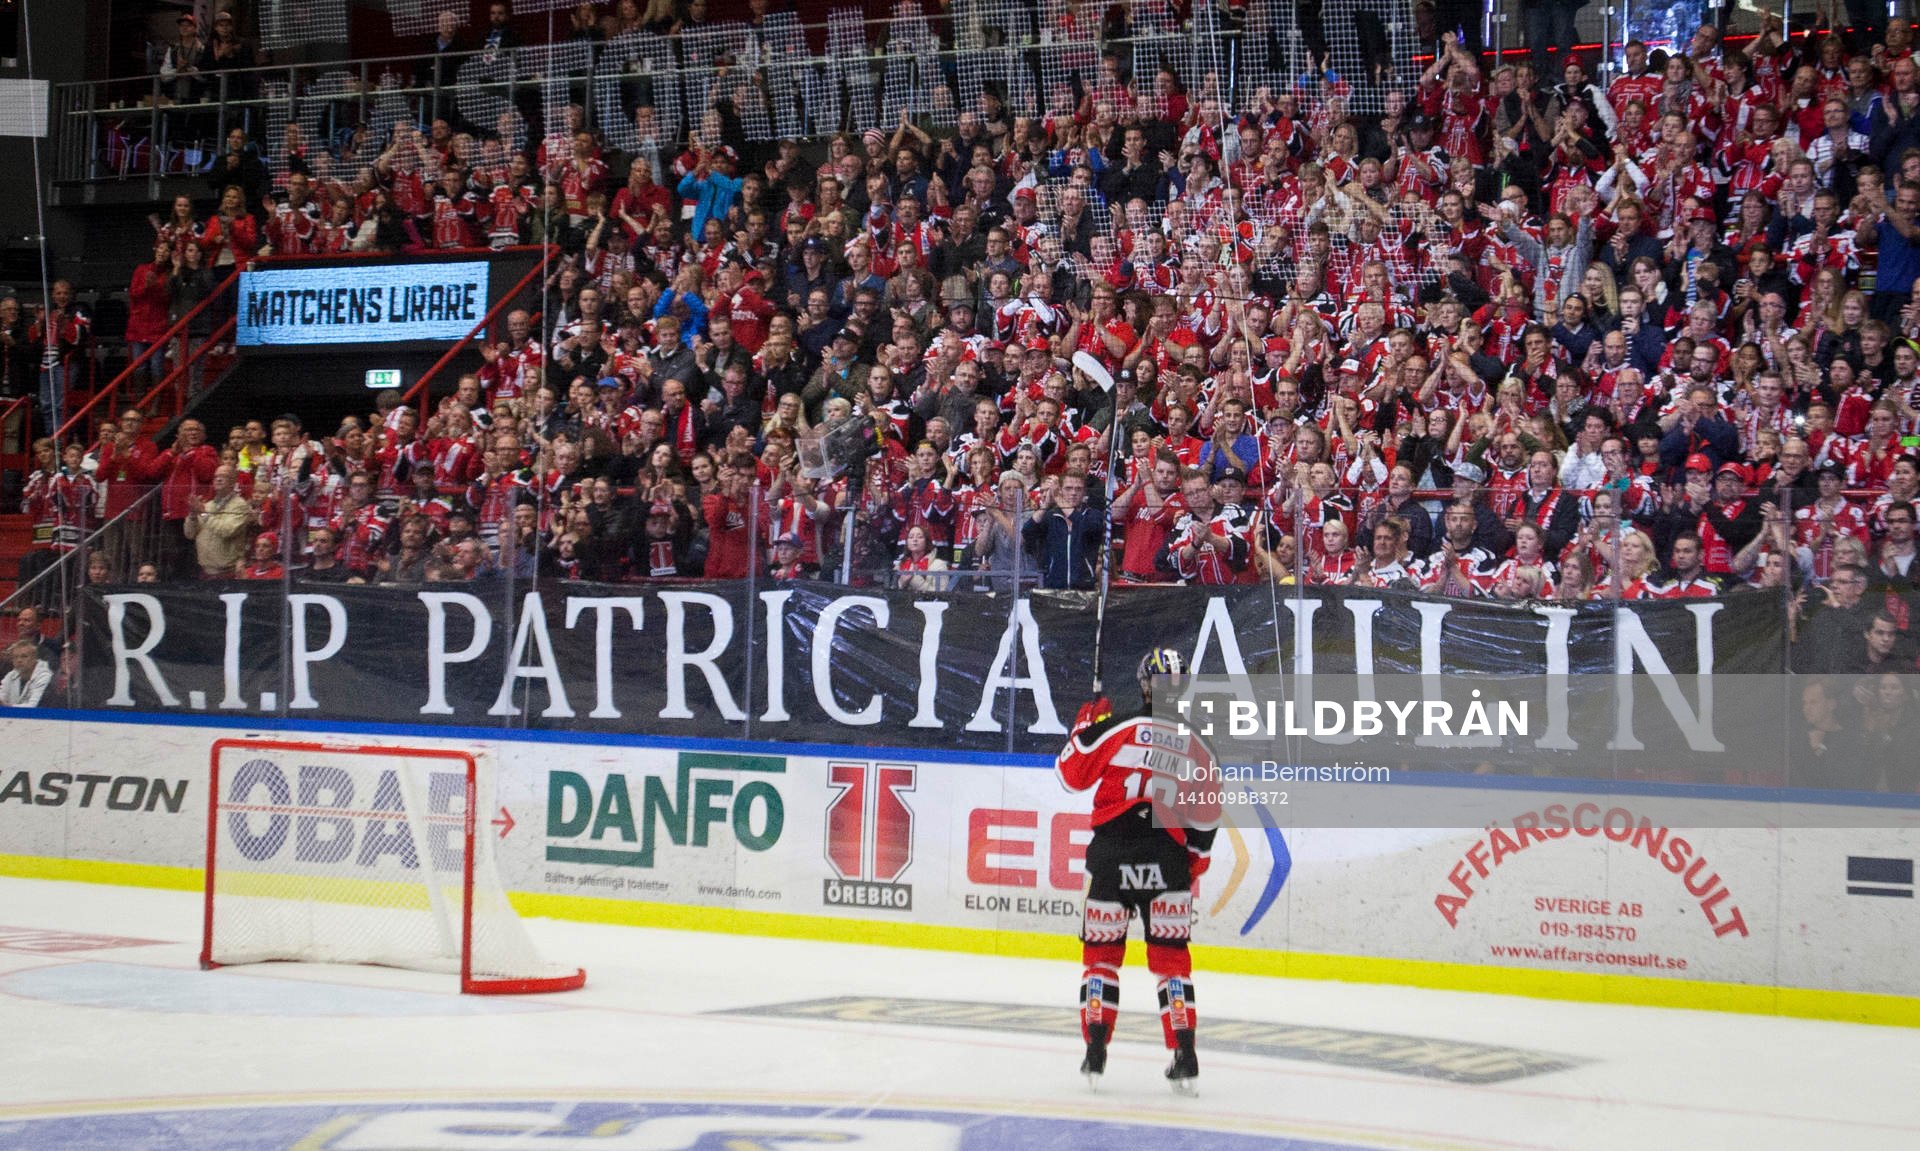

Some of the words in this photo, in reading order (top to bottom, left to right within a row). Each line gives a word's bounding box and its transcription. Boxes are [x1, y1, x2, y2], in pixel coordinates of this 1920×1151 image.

[248, 287, 383, 327] MATCHENS
[102, 592, 348, 710] R.I.P
[418, 590, 1067, 734] PATRICIA
[1182, 596, 1726, 752] AULIN
[0, 770, 189, 813] ASTON
[546, 752, 787, 868] DANFO
[1119, 863, 1168, 890] NA
[1434, 802, 1749, 938] AFFÄRSCONSULT
[827, 880, 909, 908] ÖREBRO
[965, 894, 1010, 912] ELON
[1016, 897, 1081, 917] ELKED
[1534, 897, 1611, 916] SVERIGE
[1618, 902, 1643, 917] AB
[1539, 921, 1637, 942] 019-184570
[1490, 943, 1687, 970] www.affarsconsult.se
